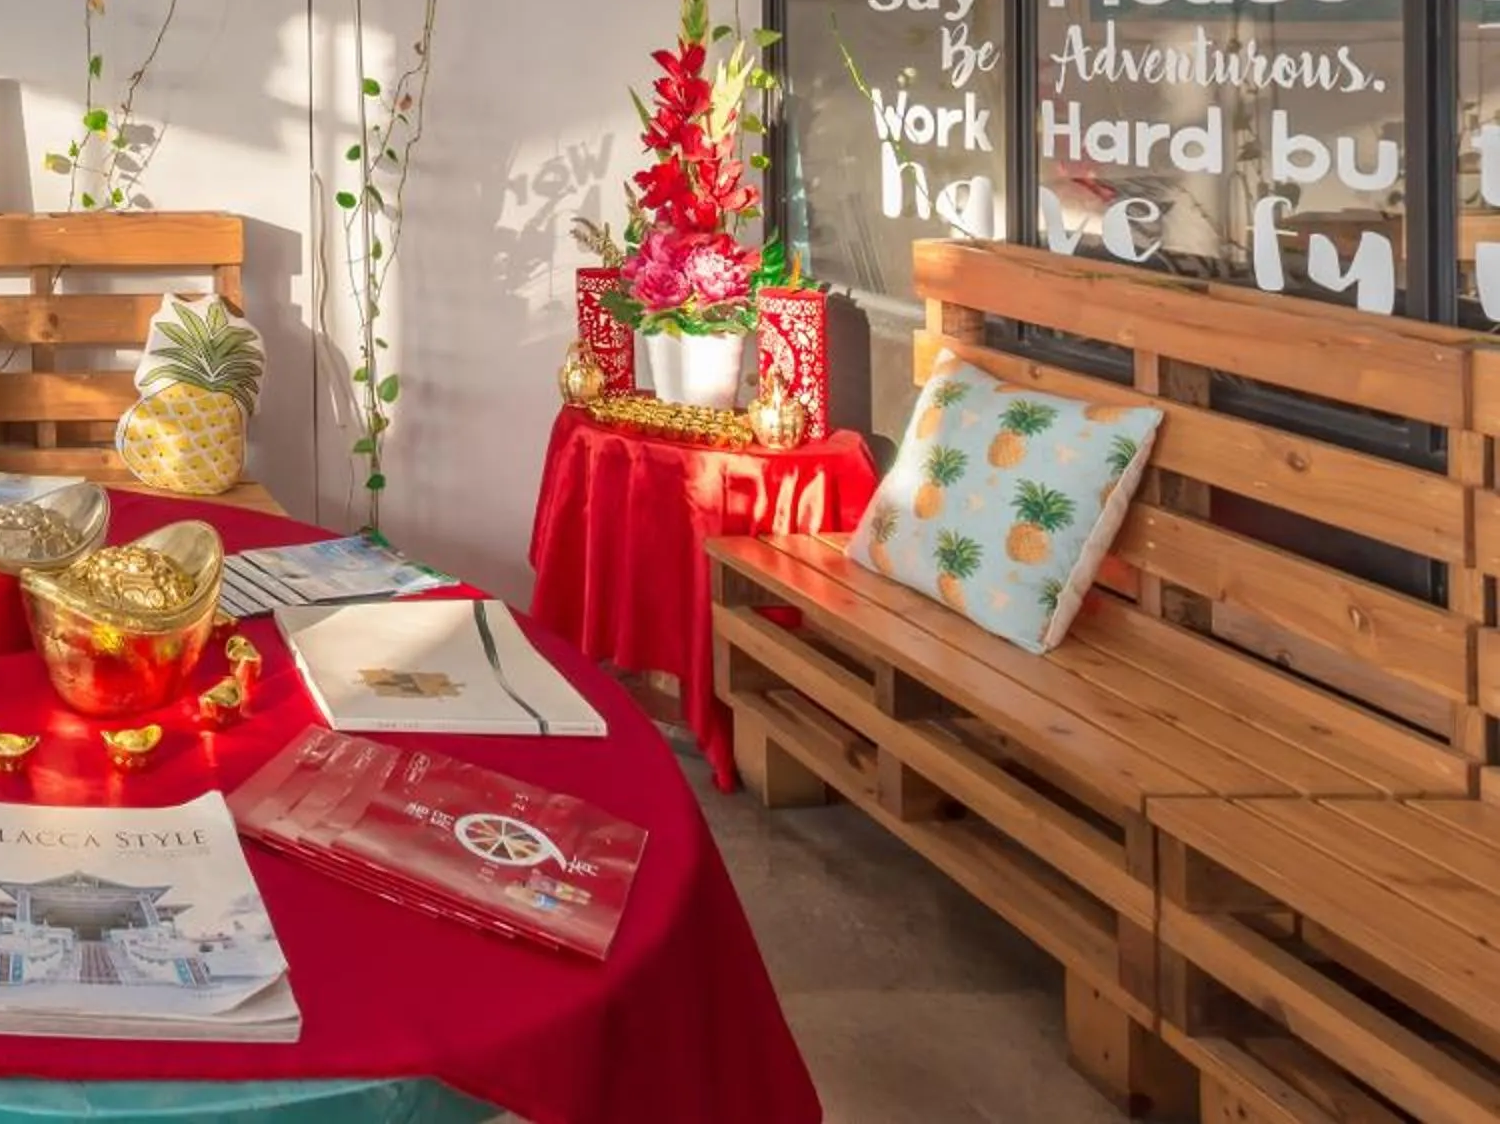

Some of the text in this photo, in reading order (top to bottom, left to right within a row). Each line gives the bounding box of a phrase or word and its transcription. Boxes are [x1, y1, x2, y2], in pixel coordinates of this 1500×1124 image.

[940, 20, 1387, 95] Be Adventurous.
[871, 87, 993, 151] Work
[1041, 100, 1225, 173] Hard
[114, 828, 209, 848] STYLE
